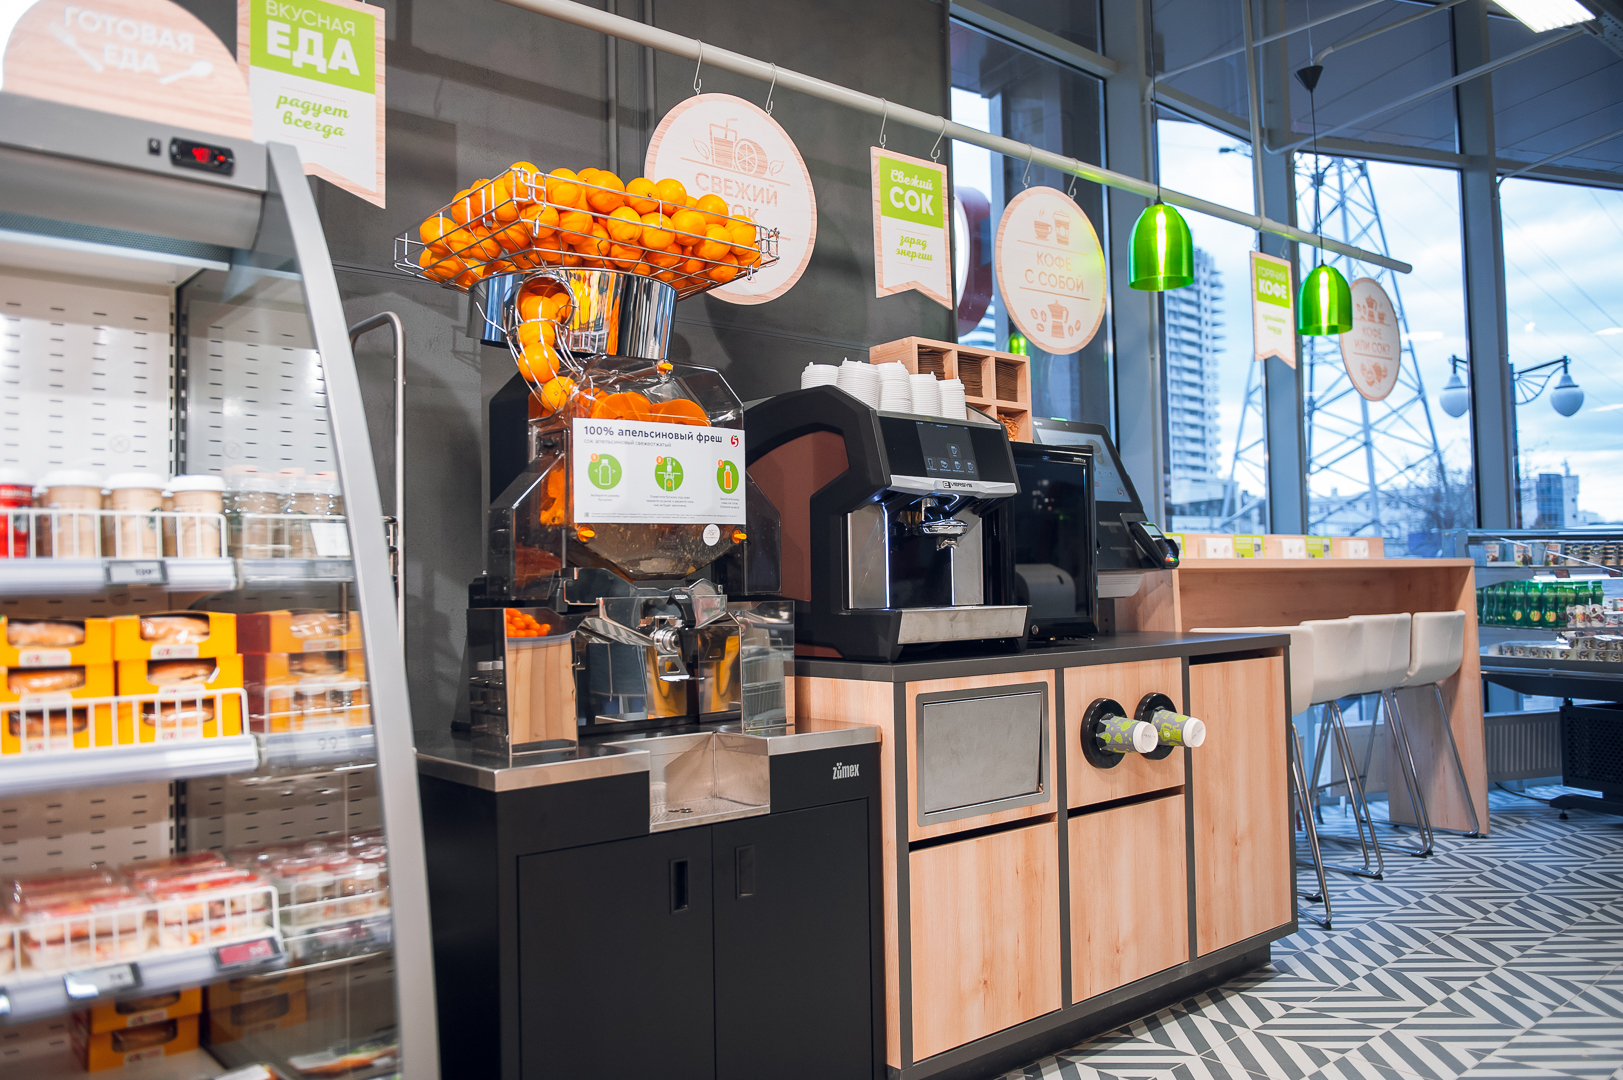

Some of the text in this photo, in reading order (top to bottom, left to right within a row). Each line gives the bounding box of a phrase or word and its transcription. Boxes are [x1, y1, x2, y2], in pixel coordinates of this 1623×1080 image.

[265, 0, 356, 36] ВКУСНАЯ
[63, 6, 195, 54] ГОТОВАЯ
[102, 43, 161, 73] ЕДА
[266, 19, 361, 76] ЕДА
[276, 94, 350, 119] радует
[282, 111, 346, 137] всегда
[695, 172, 778, 207] СВЕЖИЙ
[890, 169, 933, 191] Свежий
[889, 186, 934, 216] СОК
[899, 234, 928, 250] заряд
[895, 248, 933, 262] энергии
[1036, 253, 1072, 272] КОФЕ
[1024, 269, 1084, 293] С СОБОЙ
[1257, 265, 1286, 283] ГОРЯЧИЙ
[1258, 278, 1287, 299] КОФЕ
[1362, 325, 1383, 340] КОФЕ
[584, 425, 723, 444] 100% апельсиновый фреш
[595, 438, 635, 446] апельсиновый
[832, 762, 860, 780] zümex
